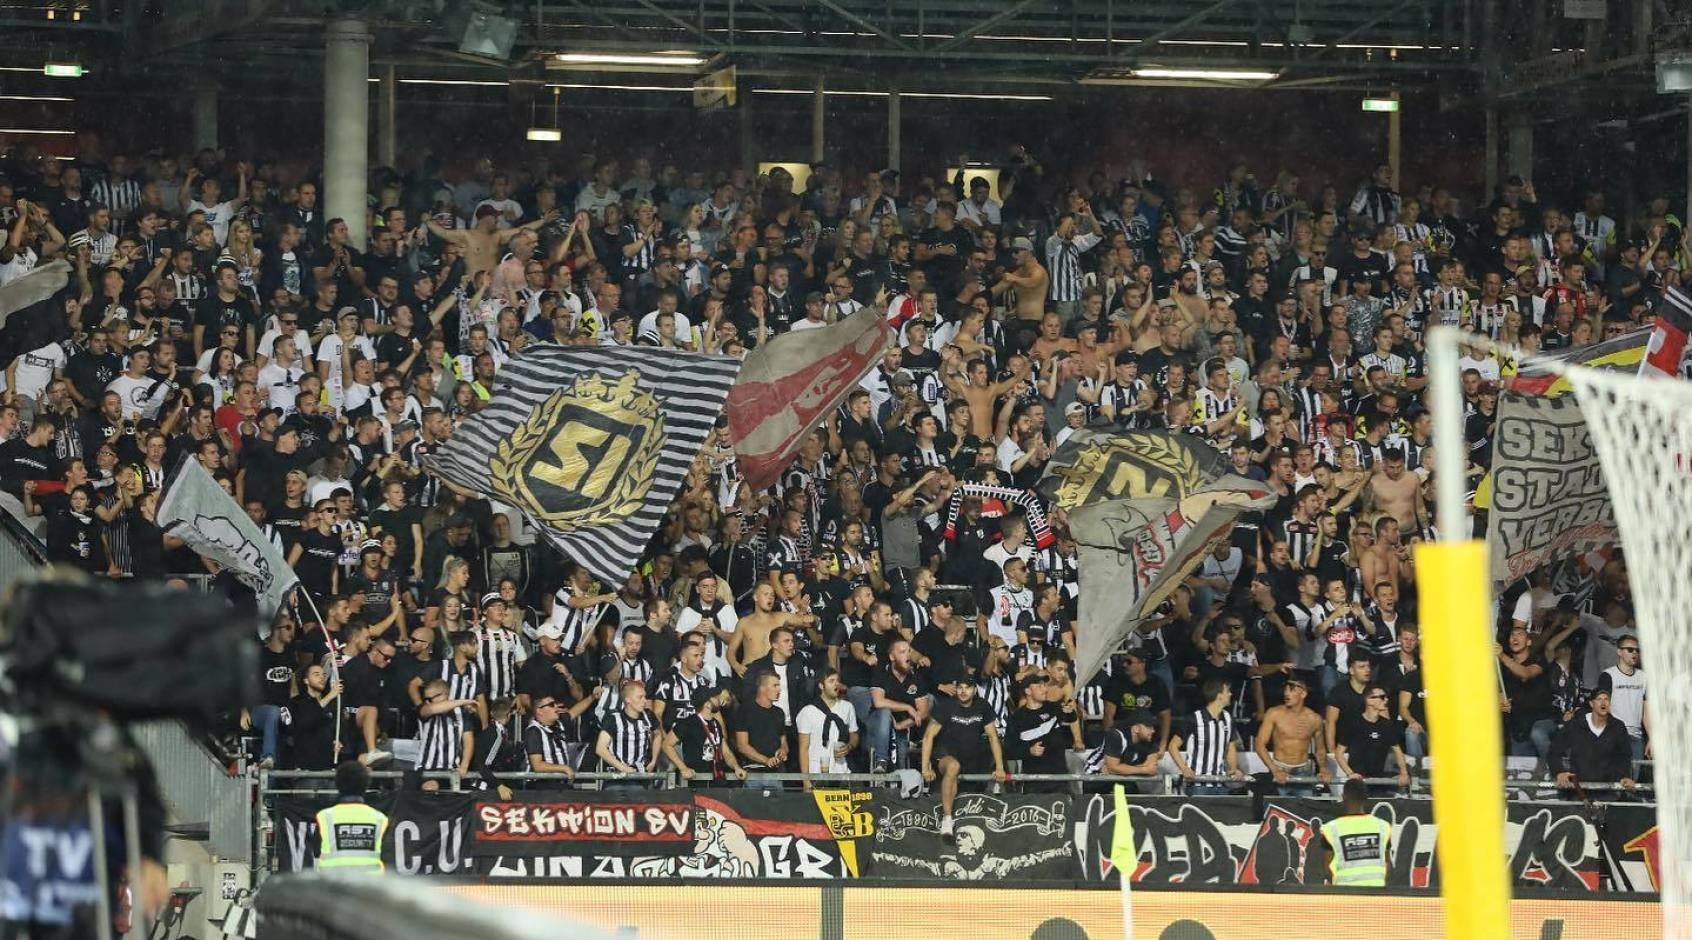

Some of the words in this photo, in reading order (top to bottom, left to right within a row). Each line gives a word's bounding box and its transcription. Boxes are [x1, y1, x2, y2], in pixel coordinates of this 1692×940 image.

[825, 794, 850, 802] BERN
[955, 798, 985, 816] Adi
[644, 807, 690, 835] SV
[20, 826, 91, 878] TV
